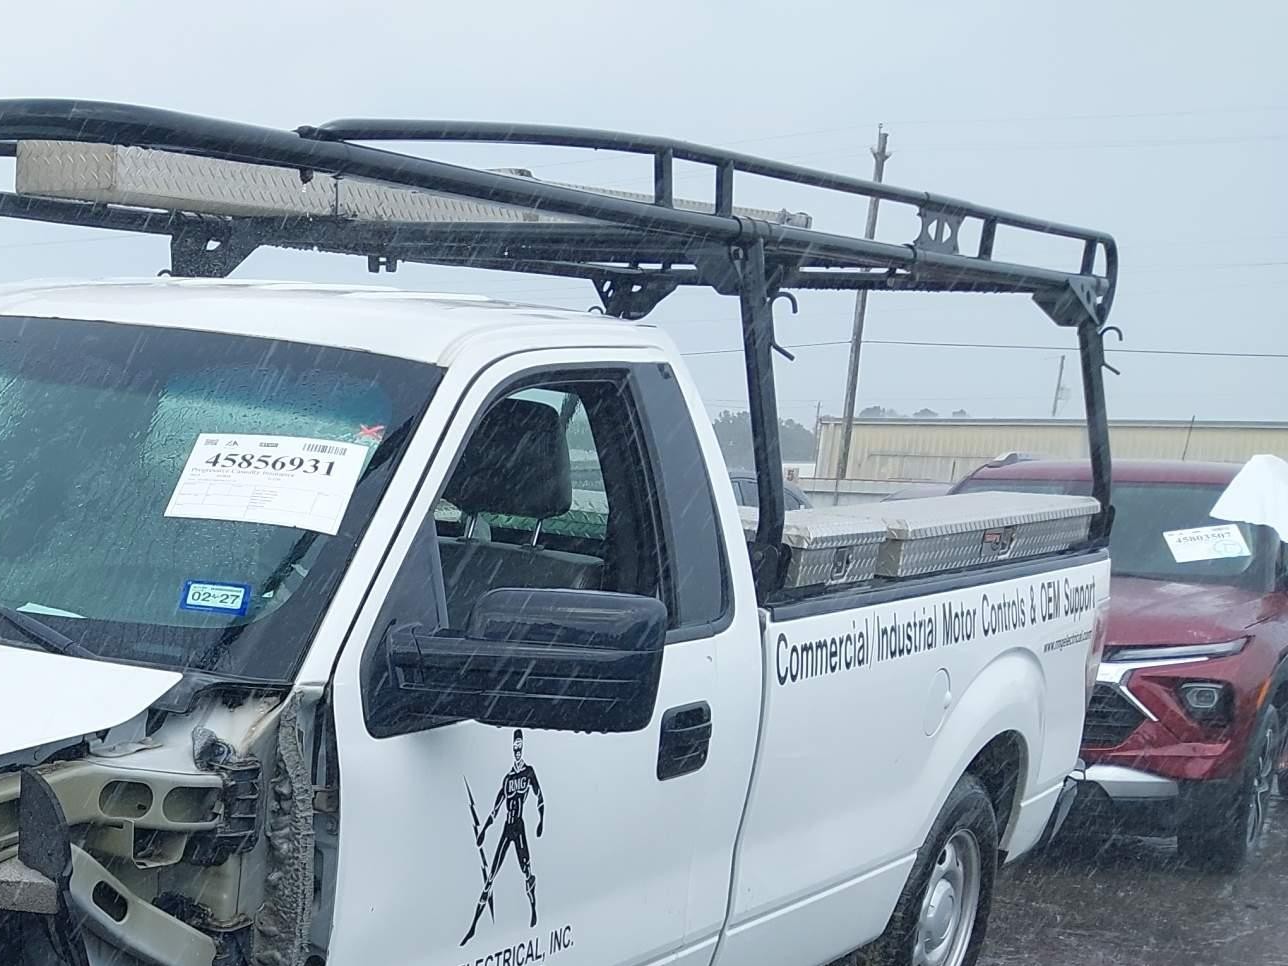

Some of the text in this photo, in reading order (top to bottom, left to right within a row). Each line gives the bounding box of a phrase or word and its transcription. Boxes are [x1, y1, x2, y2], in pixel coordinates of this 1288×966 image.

[205, 452, 335, 476] 45856931
[942, 601, 978, 649] Motor
[981, 592, 1027, 637] Controls
[1029, 585, 1038, 624] &
[1040, 579, 1061, 623] OEM
[1064, 575, 1097, 623] Support
[508, 776, 528, 793] RMG
[549, 925, 575, 956] INC.
